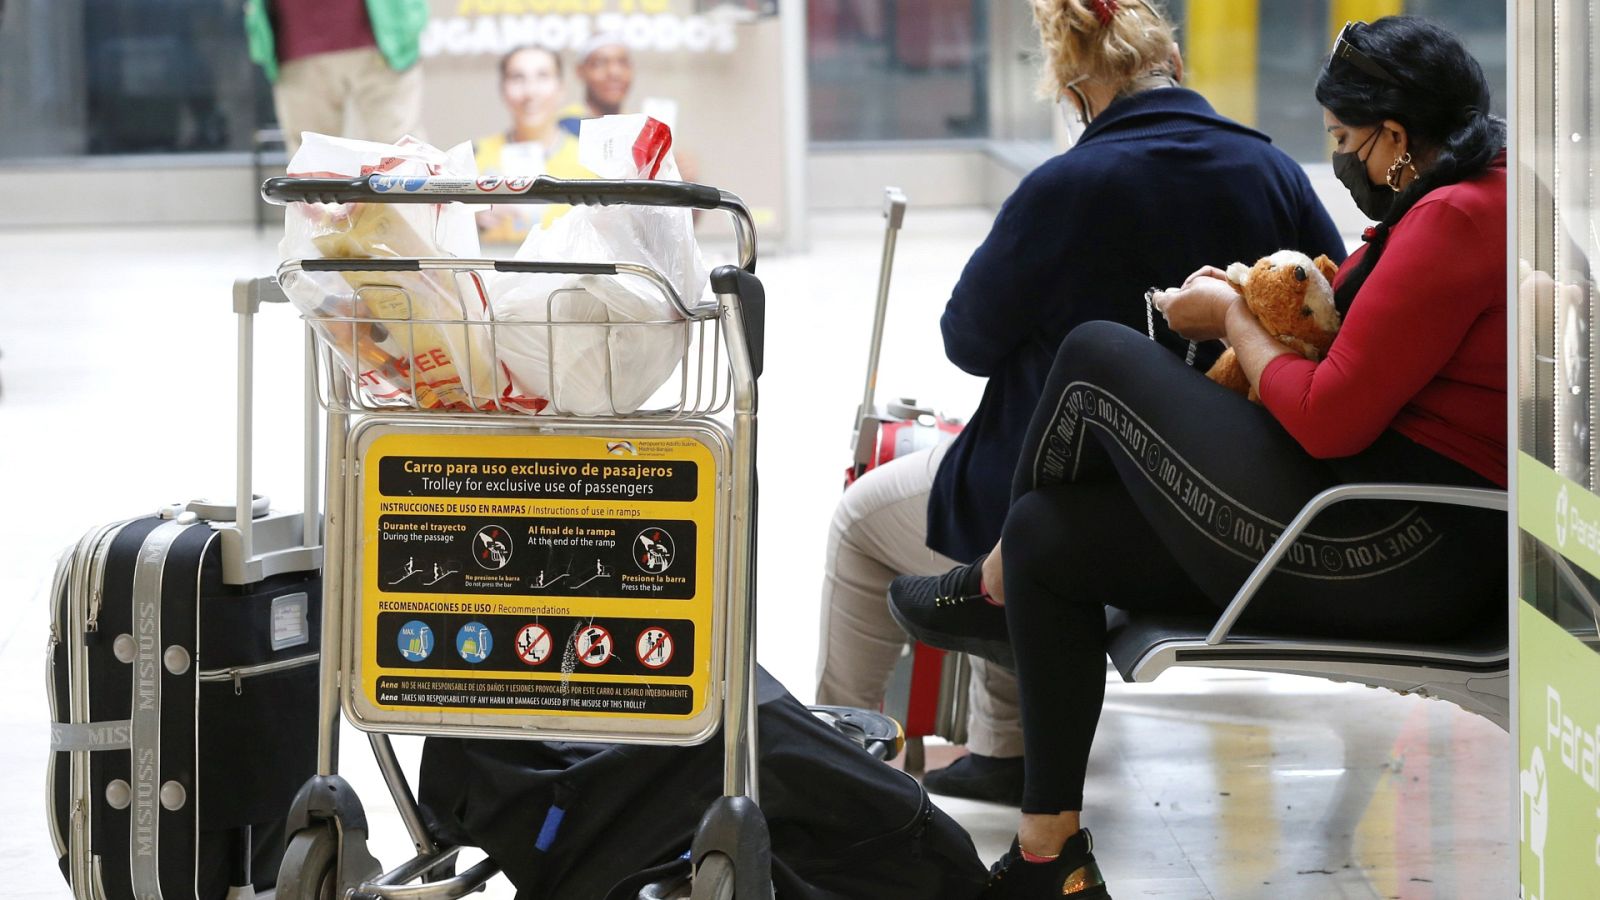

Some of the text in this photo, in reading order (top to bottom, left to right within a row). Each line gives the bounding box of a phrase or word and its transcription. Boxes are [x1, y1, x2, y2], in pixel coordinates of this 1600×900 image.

[1098, 398, 1118, 430] YOU
[1120, 415, 1148, 458] LOVE
[404, 460, 673, 479] Carro para uso exclusivo de pasajeros
[1158, 458, 1182, 496] YOU
[422, 477, 654, 497] Trolley for exclusive use of passengers
[380, 502, 444, 512] INSTRUCCIONES
[447, 504, 457, 513] DE
[460, 504, 476, 513] USO
[479, 504, 489, 513] EN
[492, 505, 526, 514] RAMPAS
[533, 506, 579, 515] Instructions
[581, 506, 589, 516] of
[607, 507, 614, 516] in
[616, 509, 640, 518] ramps
[1182, 478, 1216, 524] LOVE
[383, 522, 466, 534] Durante el trayecto
[528, 526, 616, 538] Al final de la rampa
[1234, 518, 1266, 553] YOU
[1386, 516, 1433, 558] LOVE
[1571, 505, 1600, 556] Para
[383, 532, 454, 544] During the passage
[539, 537, 551, 545] the
[553, 537, 568, 546] end
[570, 537, 578, 546] of
[580, 538, 593, 546] the
[596, 539, 616, 548] ramp
[1345, 544, 1388, 568] YOU
[622, 574, 655, 583] Presione
[379, 602, 458, 612] RECOMENDACIONES
[461, 602, 472, 612] DE
[475, 603, 490, 612] USO
[498, 604, 570, 614] Recommendations
[432, 682, 467, 690] RESPONSABLE
[468, 683, 475, 691] DE
[487, 683, 504, 692] DAÑOS
[596, 687, 614, 695] CARRO
[645, 688, 688, 698] INDEBIDAMENTE
[426, 695, 469, 703] RESPONSABILITY
[541, 698, 561, 706] CAUSED
[1547, 684, 1600, 792] Para
